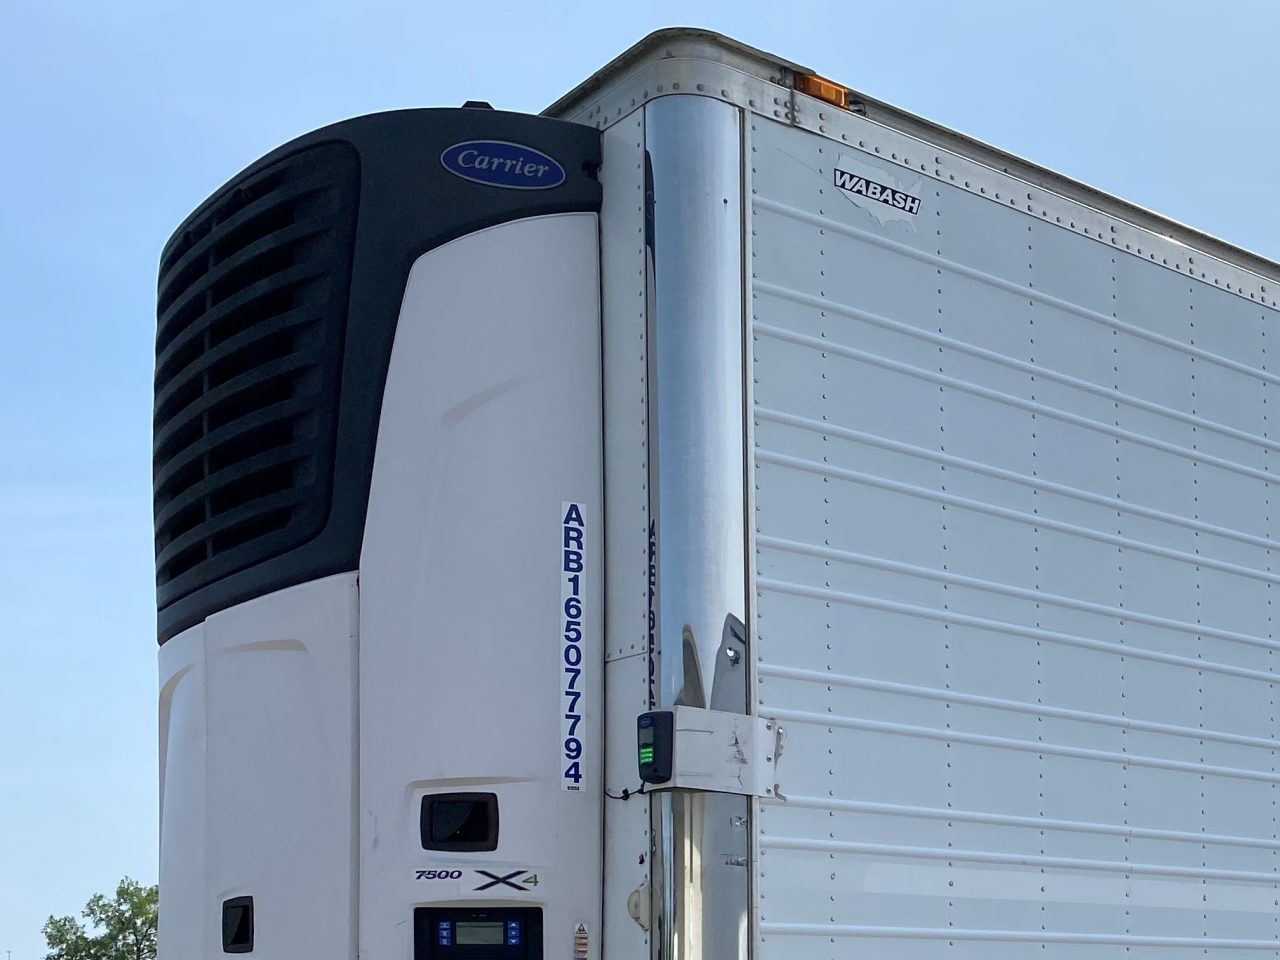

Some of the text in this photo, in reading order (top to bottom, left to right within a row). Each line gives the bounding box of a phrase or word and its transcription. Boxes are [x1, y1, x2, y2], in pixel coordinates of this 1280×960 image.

[457, 149, 550, 178] Carrier
[834, 170, 921, 214] WABASH
[563, 503, 584, 784] ARB165077794
[415, 869, 463, 880] 7500
